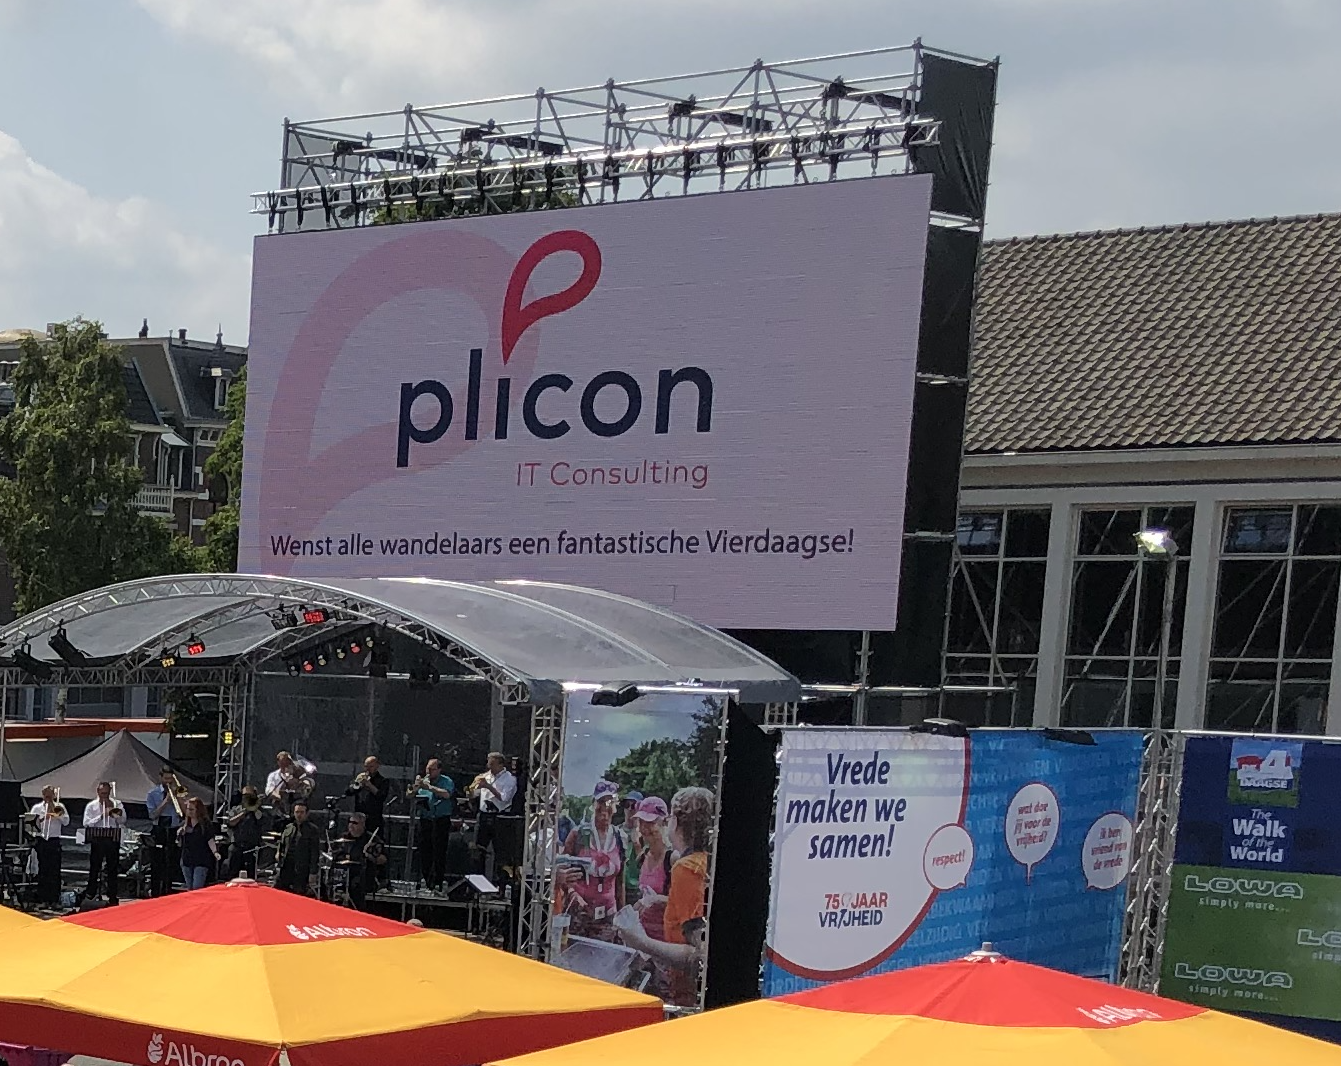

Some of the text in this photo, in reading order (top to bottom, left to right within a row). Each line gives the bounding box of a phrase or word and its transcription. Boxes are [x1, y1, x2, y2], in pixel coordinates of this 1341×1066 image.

[396, 348, 715, 468] plicon
[516, 460, 709, 489] IT Consulting
[269, 528, 855, 559] Wenst alle wandelaars een fantastische Vierdaagse!
[826, 750, 891, 785] Vrede
[785, 788, 907, 824] maken we
[1251, 808, 1272, 820] The
[1024, 818, 1040, 830] voor
[1232, 818, 1288, 838] Walk
[807, 823, 896, 860] samen!
[1241, 836, 1275, 848] of the
[931, 849, 966, 869] respect!
[1229, 845, 1284, 863] World
[1184, 874, 1304, 900] LOWA
[824, 891, 889, 910] 75 JAAR
[1198, 896, 1240, 909] simply
[818, 908, 884, 930] VRIJHEID
[303, 924, 378, 940] Albron
[1174, 962, 1293, 988] LOWA
[1188, 984, 1230, 998] simply
